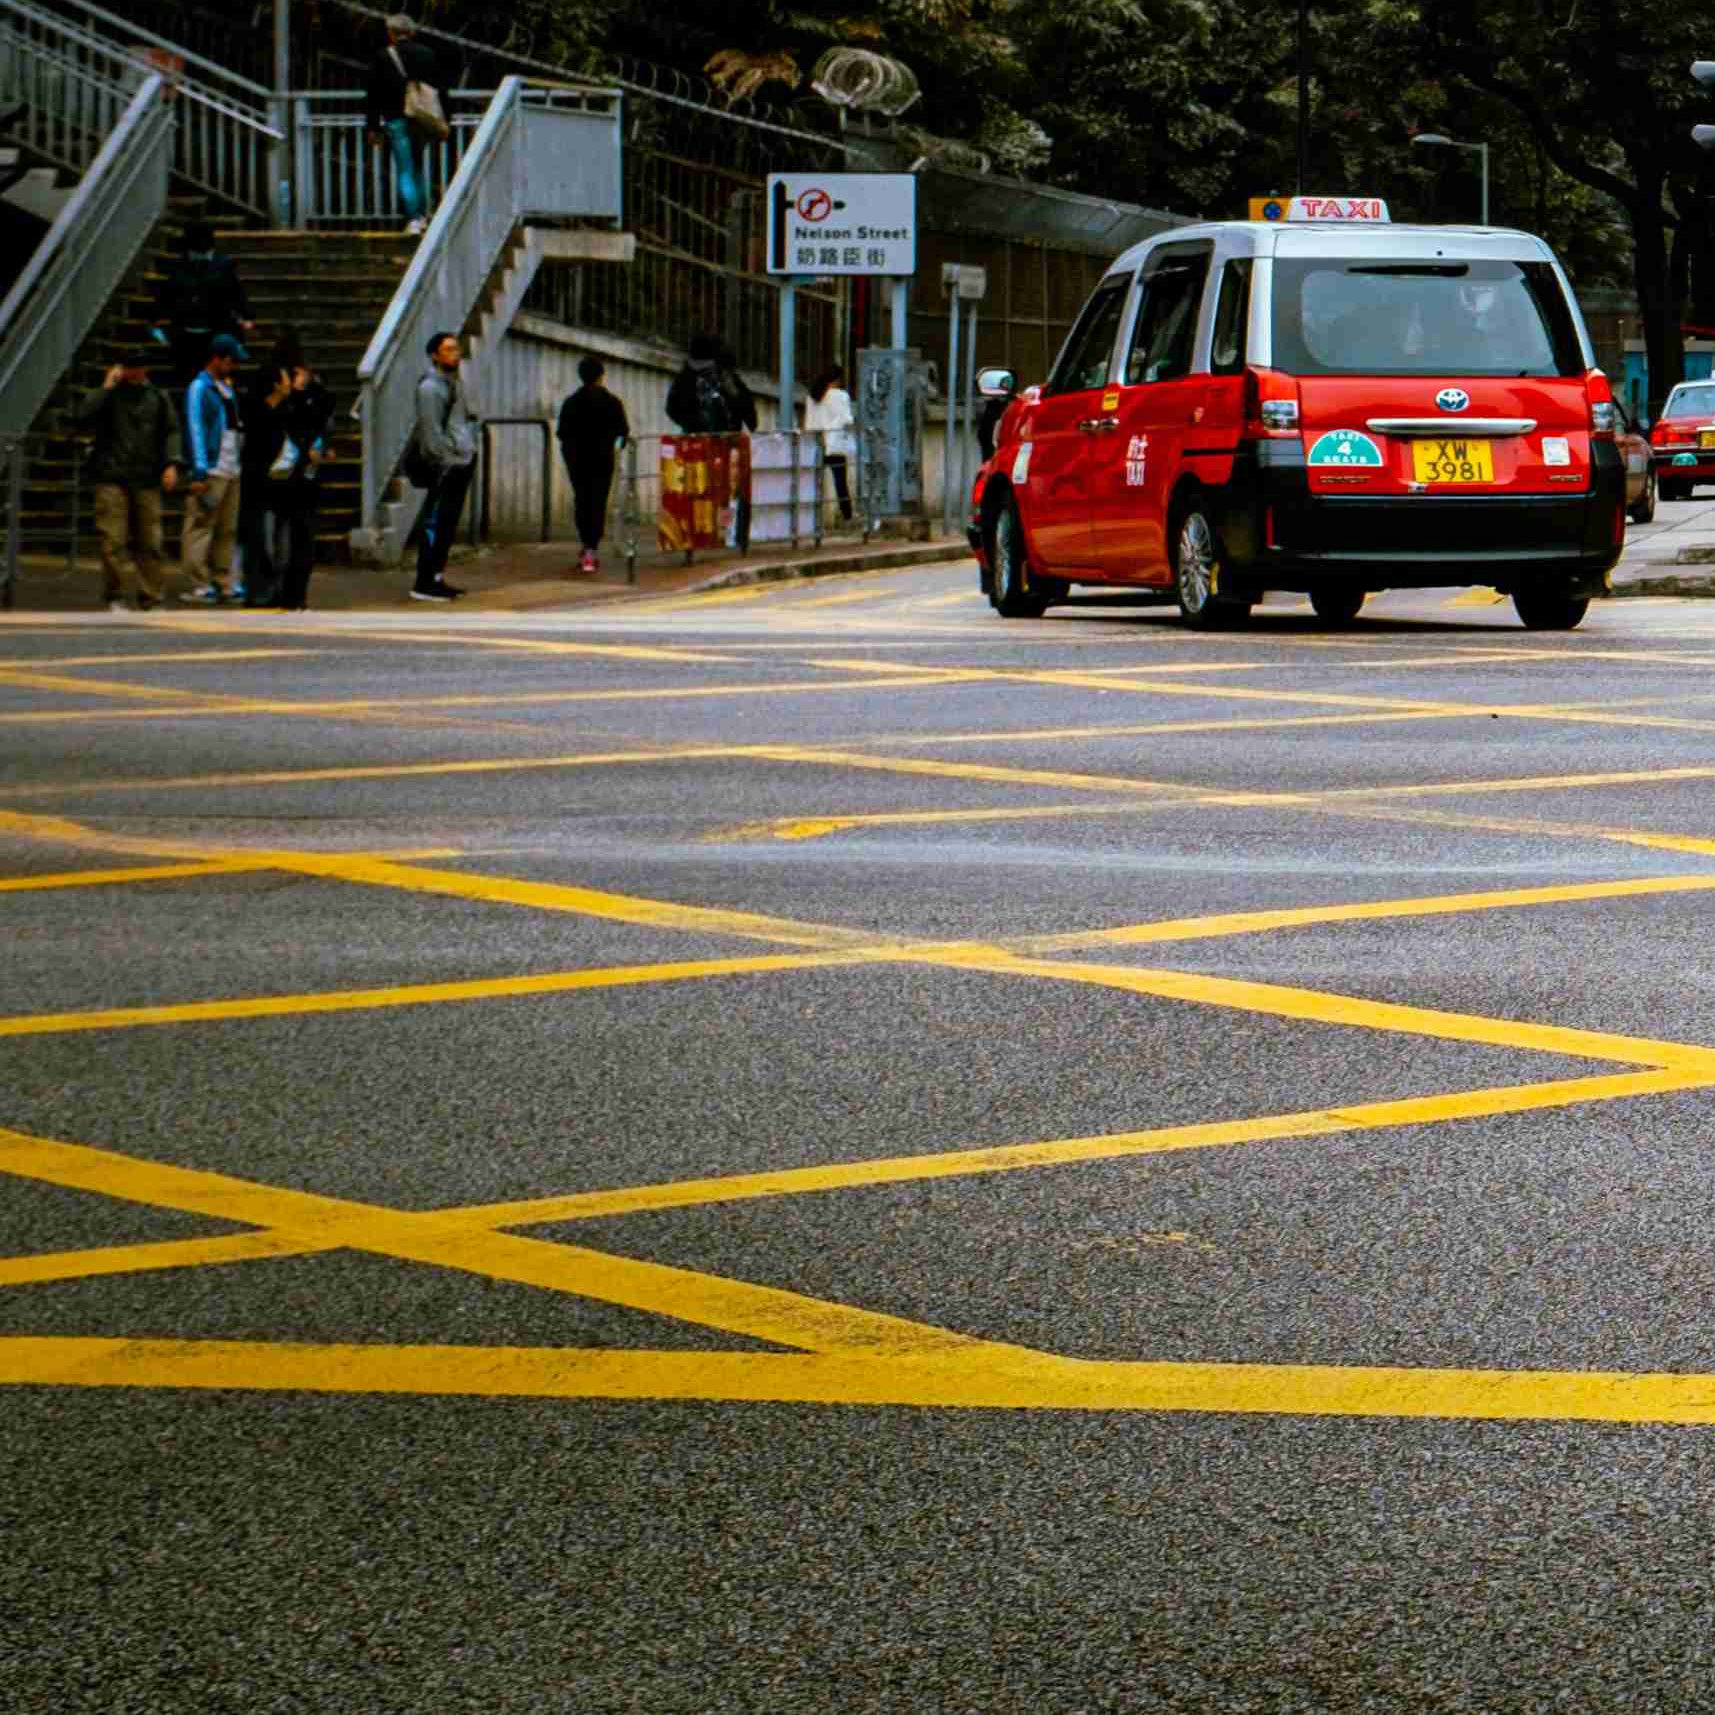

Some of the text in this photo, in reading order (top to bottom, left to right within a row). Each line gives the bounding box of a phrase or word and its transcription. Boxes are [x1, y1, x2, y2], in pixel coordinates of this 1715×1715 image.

[1301, 198, 1381, 218] TAXI
[795, 226, 910, 239] Nelson Street
[796, 247, 886, 267] 奶路臣街
[1337, 441, 1352, 456] 4
[1437, 440, 1469, 462] XW
[1424, 461, 1485, 482] 3981
